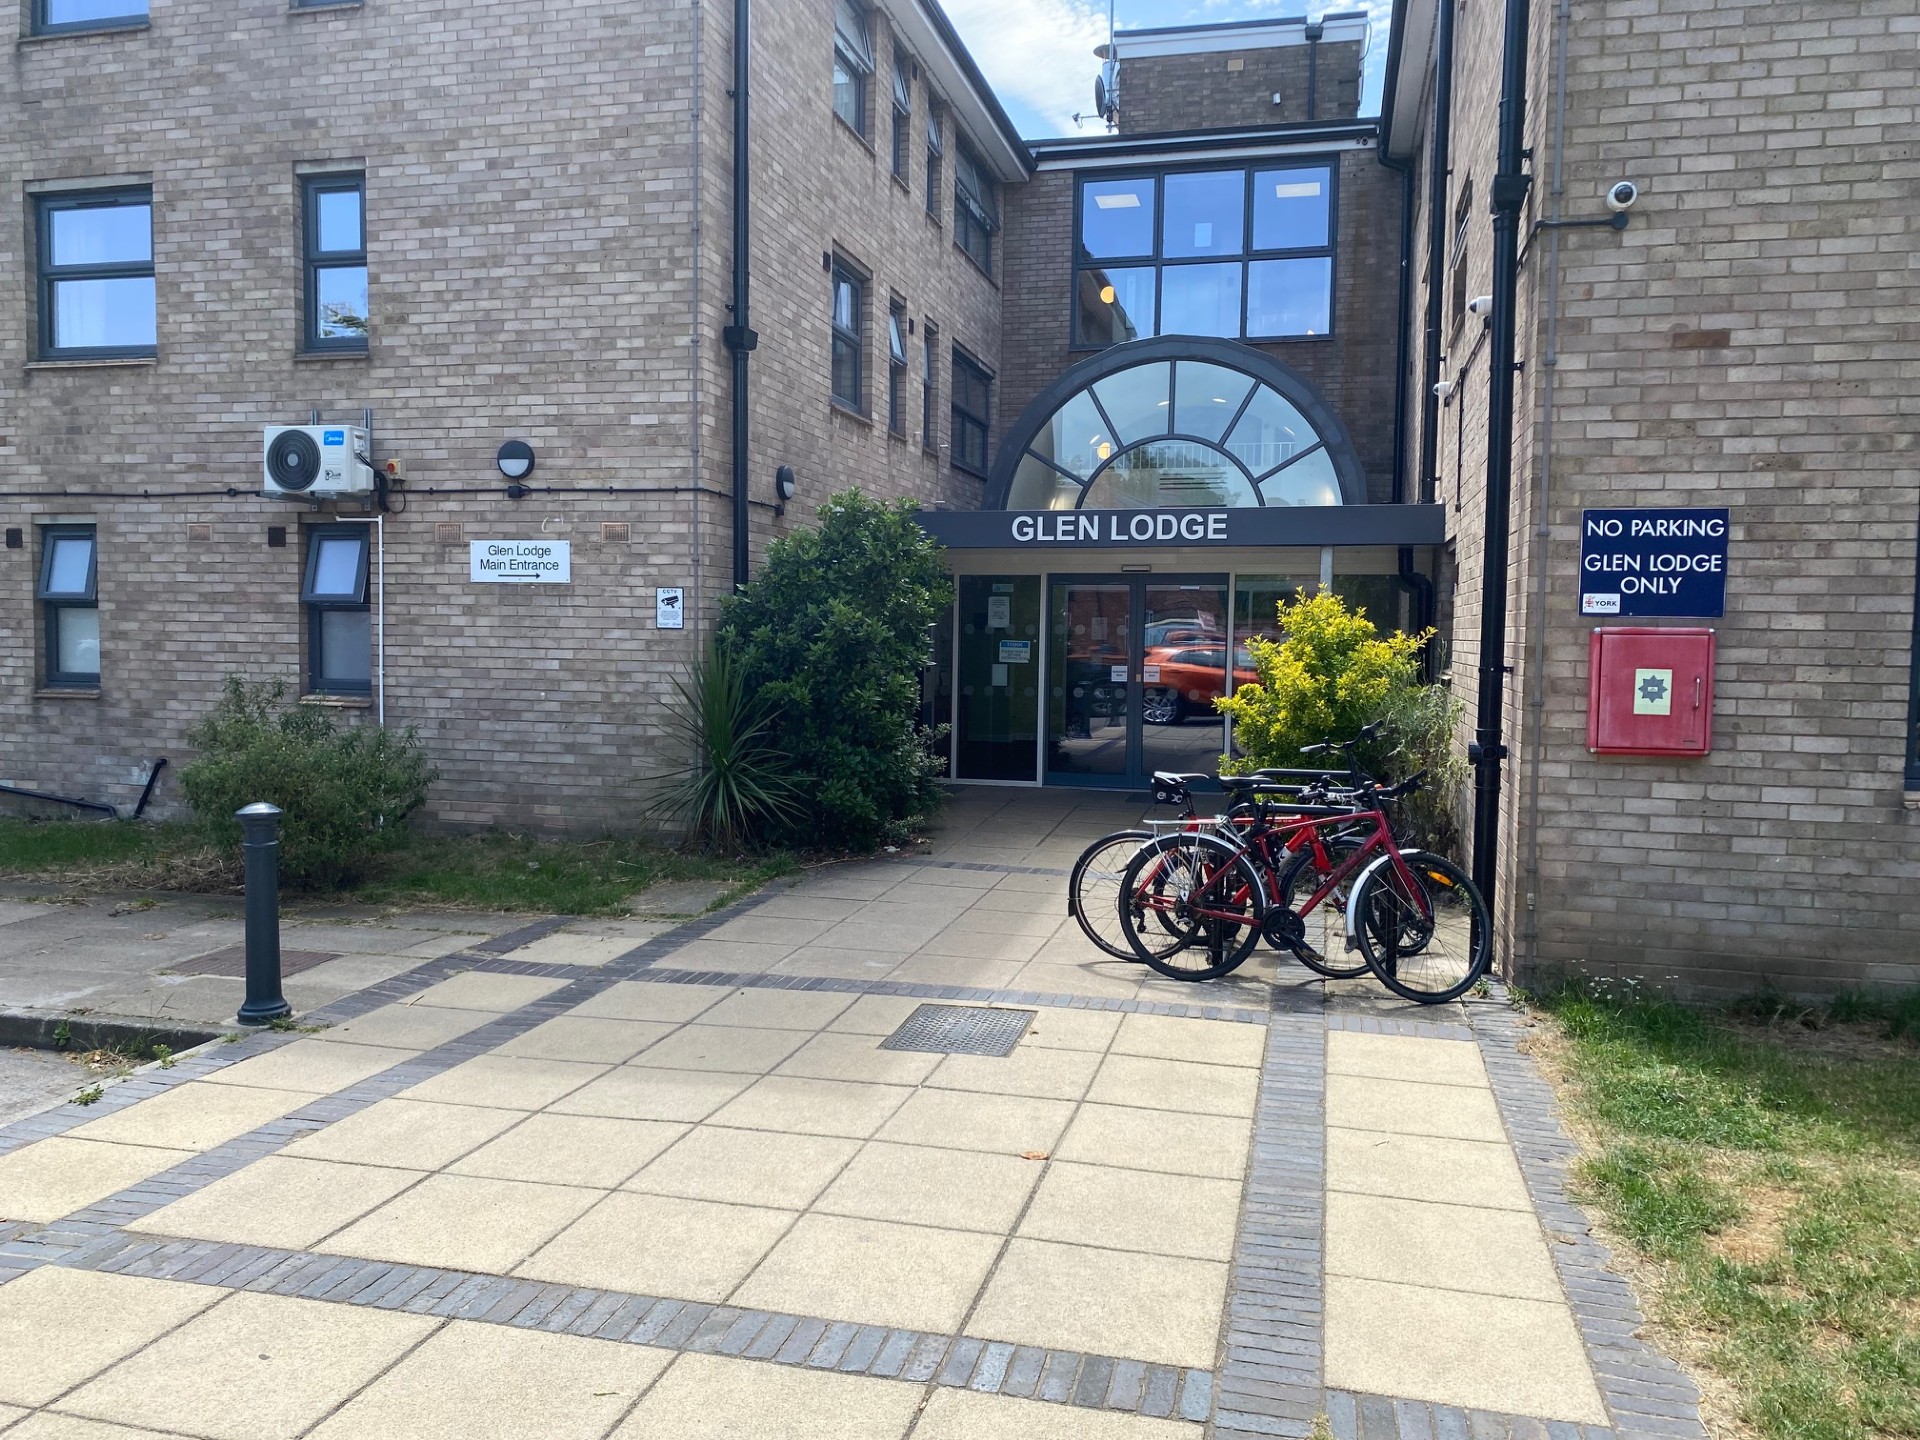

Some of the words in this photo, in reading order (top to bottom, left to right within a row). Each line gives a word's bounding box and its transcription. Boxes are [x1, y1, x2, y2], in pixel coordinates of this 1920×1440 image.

[1011, 515, 1099, 541] GLEN
[1110, 513, 1228, 541] LODGE
[1587, 519, 1623, 537] NO
[1631, 519, 1725, 537] PARKING
[488, 544, 514, 556] Glen
[516, 544, 552, 559] Lodge
[480, 558, 506, 570] Main
[509, 558, 559, 570] Entrance
[1584, 554, 1641, 572] GLEN
[1649, 554, 1722, 572] LODGE
[1620, 576, 1683, 594] ONLY
